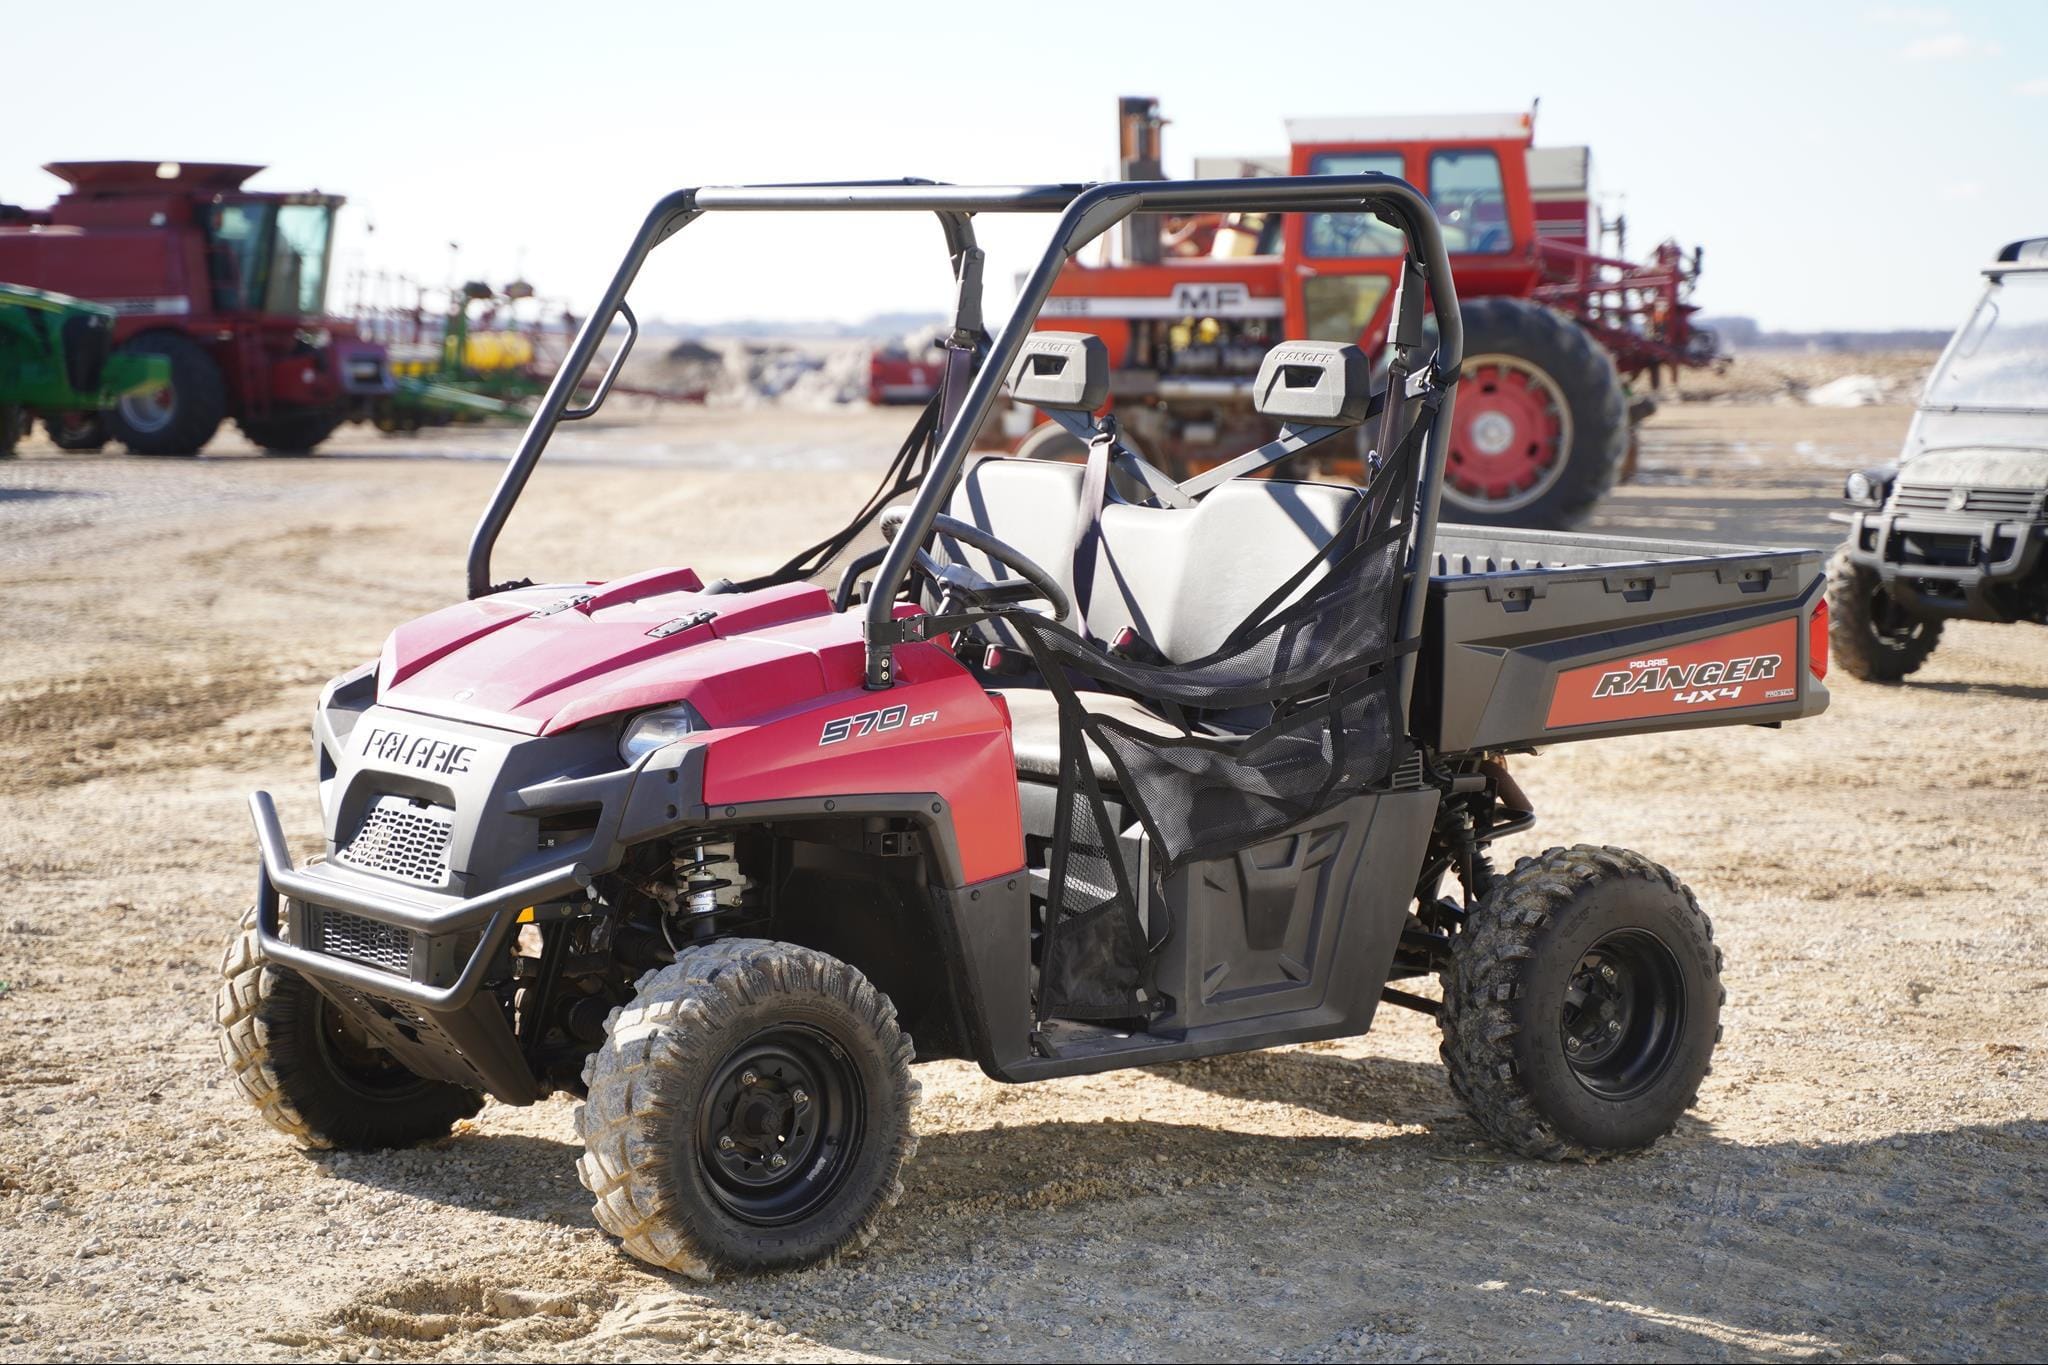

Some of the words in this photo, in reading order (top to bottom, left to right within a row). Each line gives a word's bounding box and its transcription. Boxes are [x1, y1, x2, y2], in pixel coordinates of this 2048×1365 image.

[1179, 287, 1240, 310] MF
[1025, 340, 1077, 353] RANGER
[1274, 351, 1336, 364] RANGER
[1630, 658, 1669, 669] POLARIS
[1592, 654, 1782, 698] RANGER
[819, 704, 908, 746] 570
[909, 711, 939, 727] EFI
[362, 728, 477, 774] POLARIS
